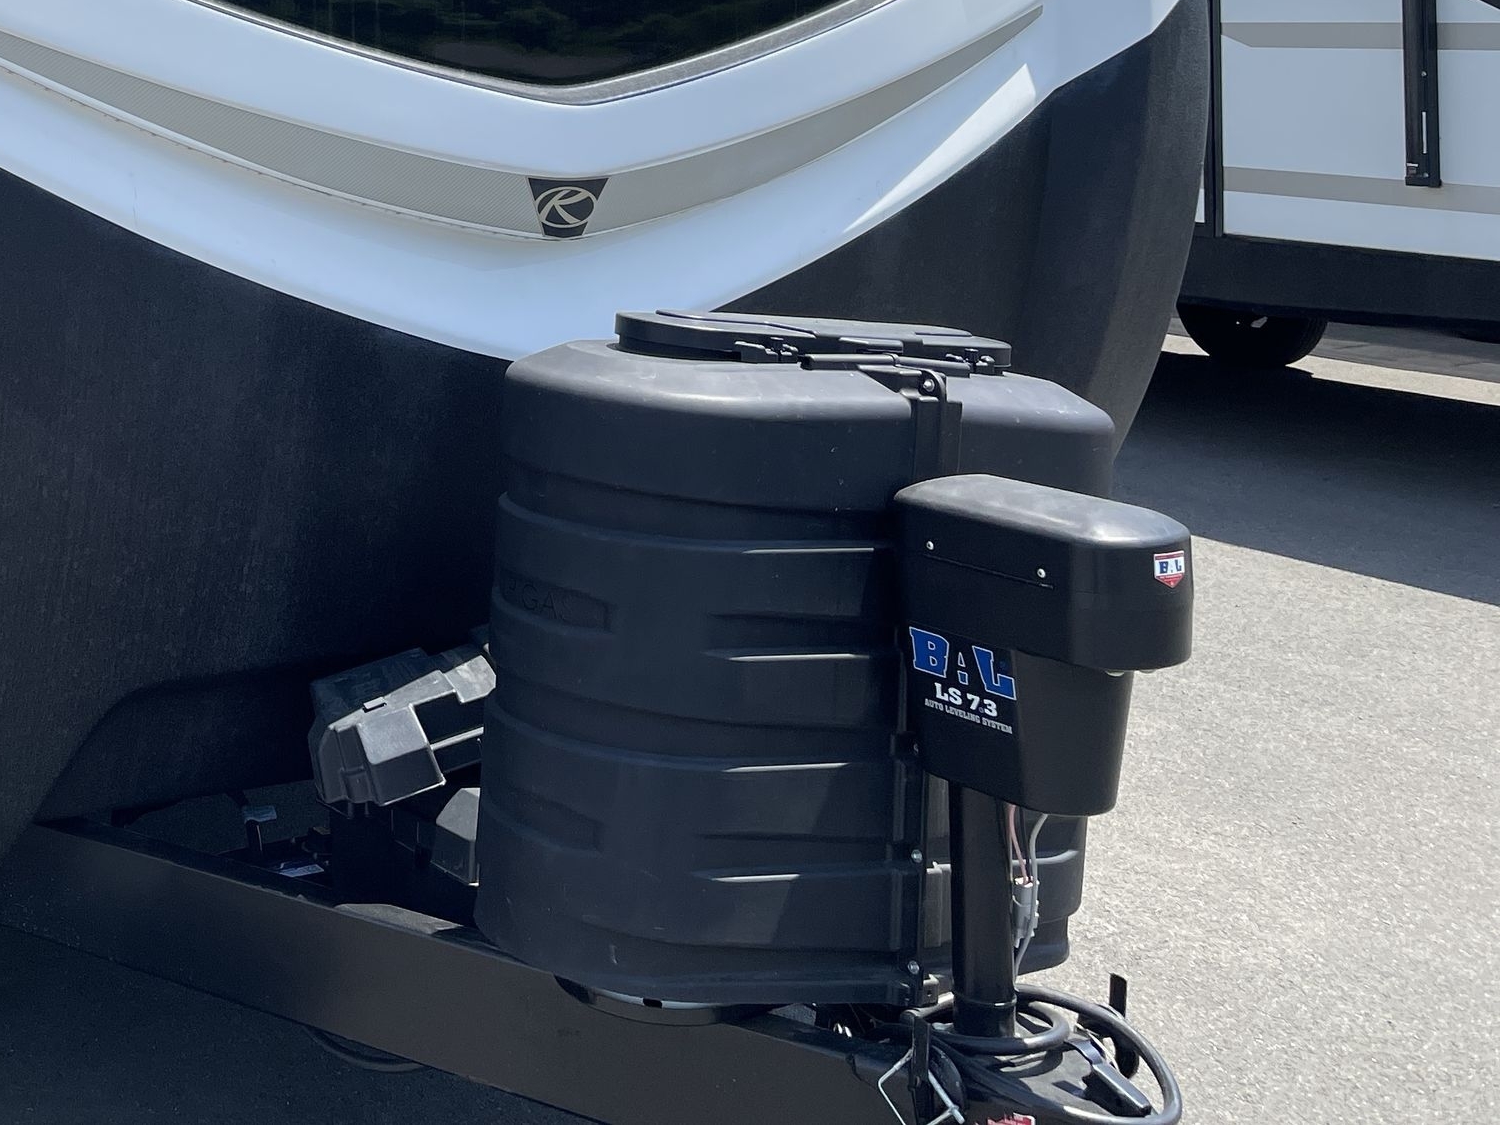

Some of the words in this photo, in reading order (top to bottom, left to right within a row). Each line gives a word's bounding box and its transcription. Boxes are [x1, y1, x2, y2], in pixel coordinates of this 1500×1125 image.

[934, 682, 962, 705] LS
[924, 698, 944, 712] AUTO
[944, 704, 981, 724] LEVELING
[982, 717, 1013, 734] SYSTEM
